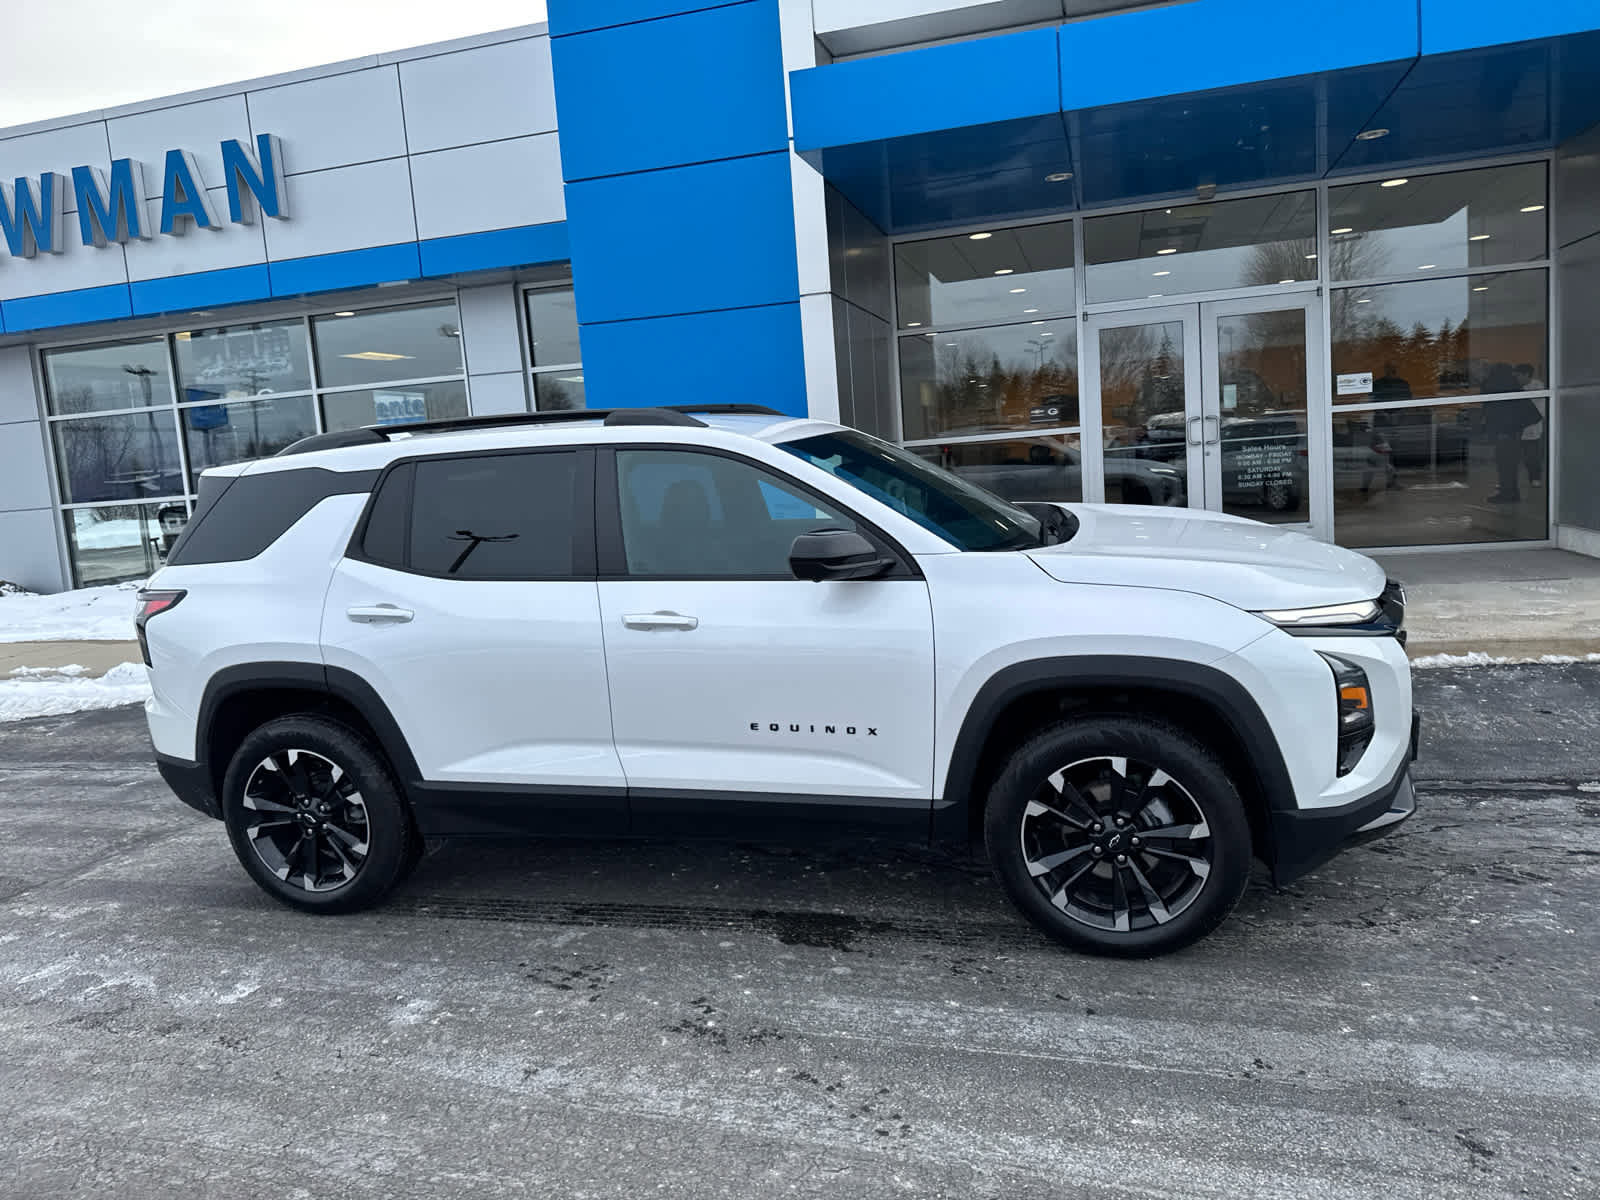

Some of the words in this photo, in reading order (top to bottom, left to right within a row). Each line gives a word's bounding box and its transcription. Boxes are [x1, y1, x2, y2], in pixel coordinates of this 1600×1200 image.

[0, 133, 286, 258] WMAN
[1247, 466, 1281, 474] SATURDAY
[750, 723, 877, 736] EQUINOX
